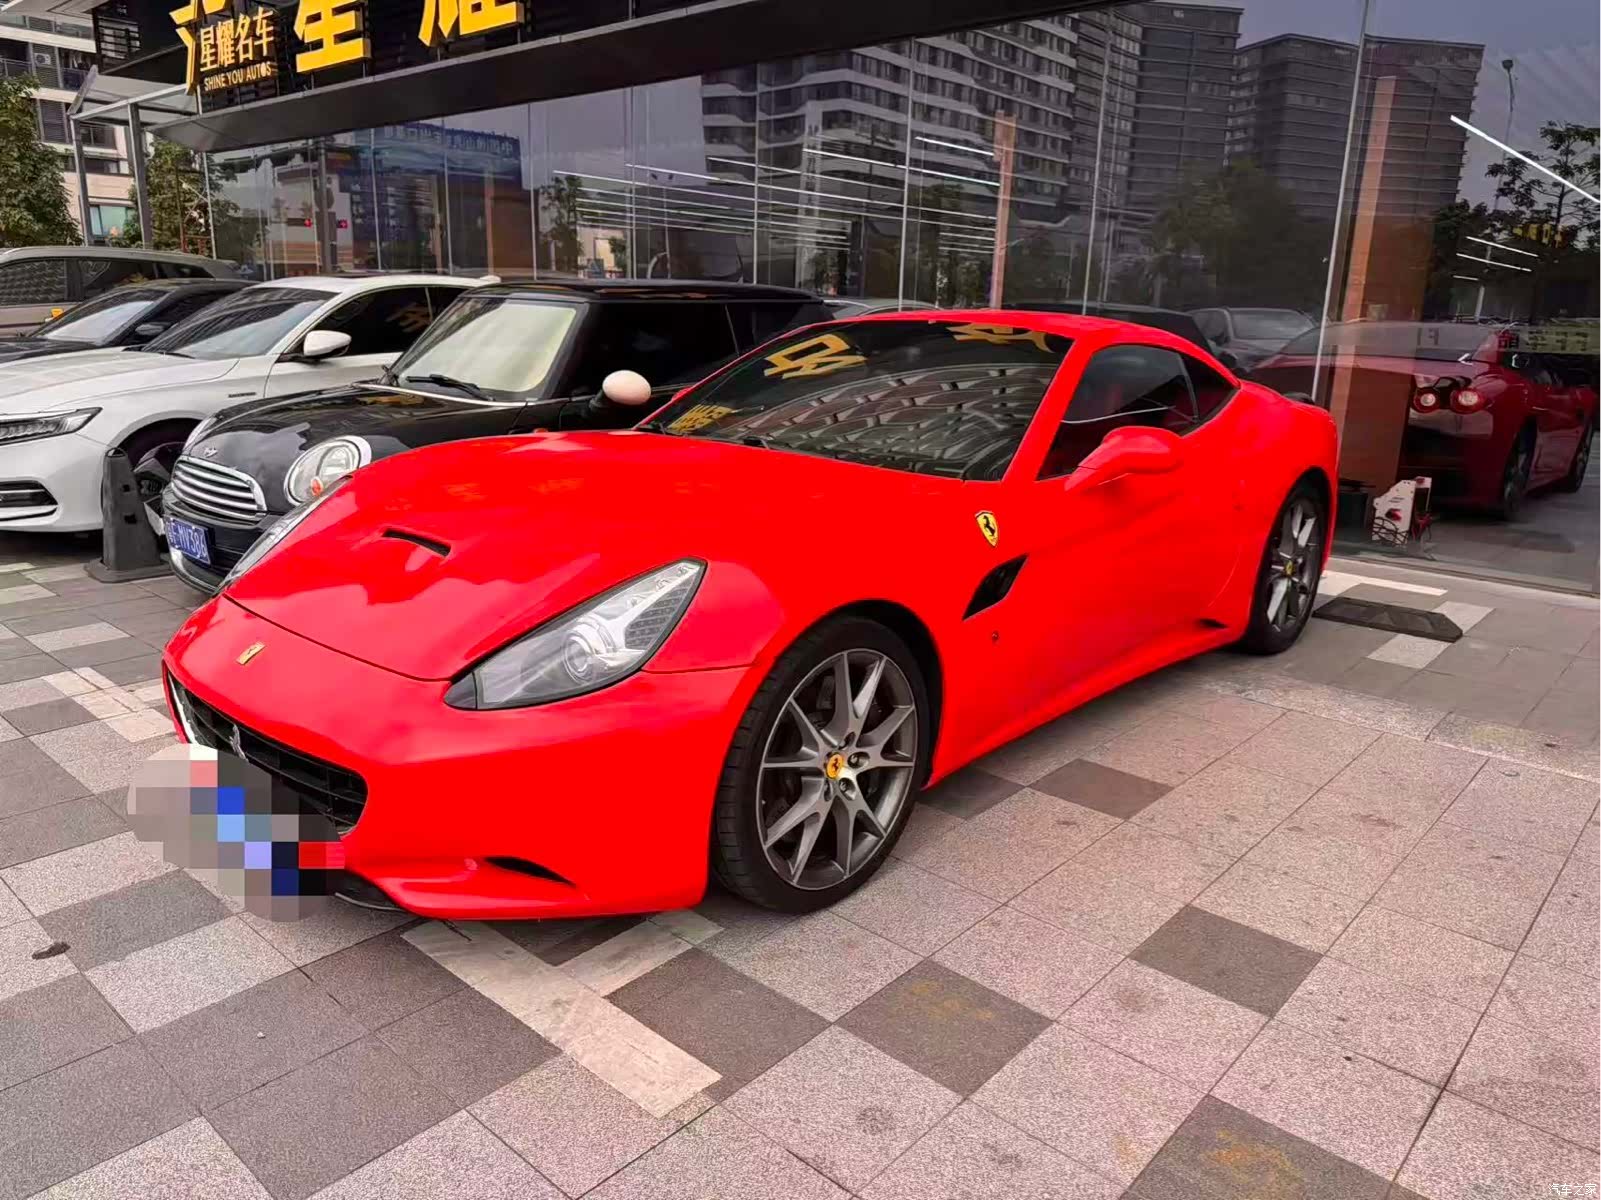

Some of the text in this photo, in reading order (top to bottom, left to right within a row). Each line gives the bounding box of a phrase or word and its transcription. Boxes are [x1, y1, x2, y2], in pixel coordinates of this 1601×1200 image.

[200, 6, 274, 72] 星耀名车
[204, 61, 272, 91] SHINE YOU AUTOS
